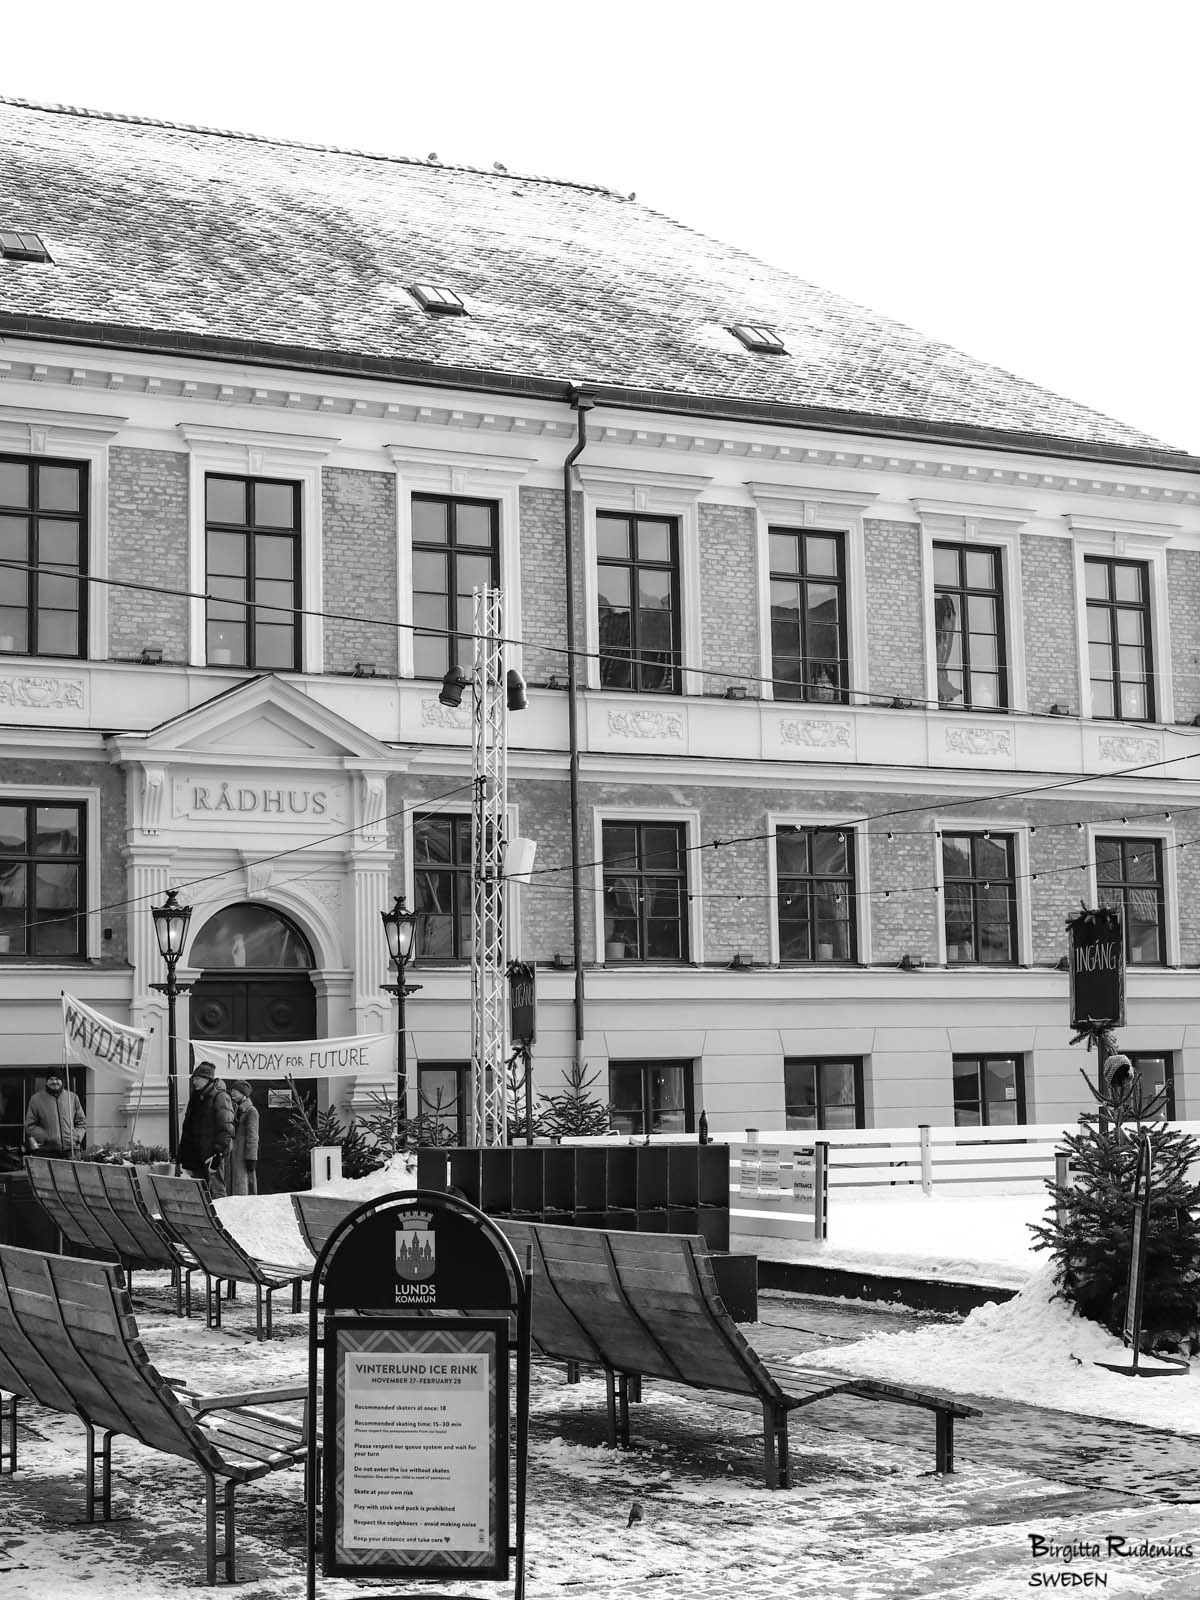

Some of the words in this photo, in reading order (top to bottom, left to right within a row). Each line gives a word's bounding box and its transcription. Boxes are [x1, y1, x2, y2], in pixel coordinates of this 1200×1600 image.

[193, 782, 327, 814] RÅDHUS
[65, 1006, 144, 1071] MAYDAY!
[227, 1051, 283, 1071] MAYDAY
[286, 1056, 304, 1068] FOR
[310, 1048, 369, 1069] FUTURE
[395, 1284, 436, 1295] LUNDS
[395, 1296, 436, 1304] KOMMUN
[356, 1364, 426, 1374] VINTERLUND
[430, 1365, 448, 1374] ICE
[450, 1365, 478, 1374] RINK
